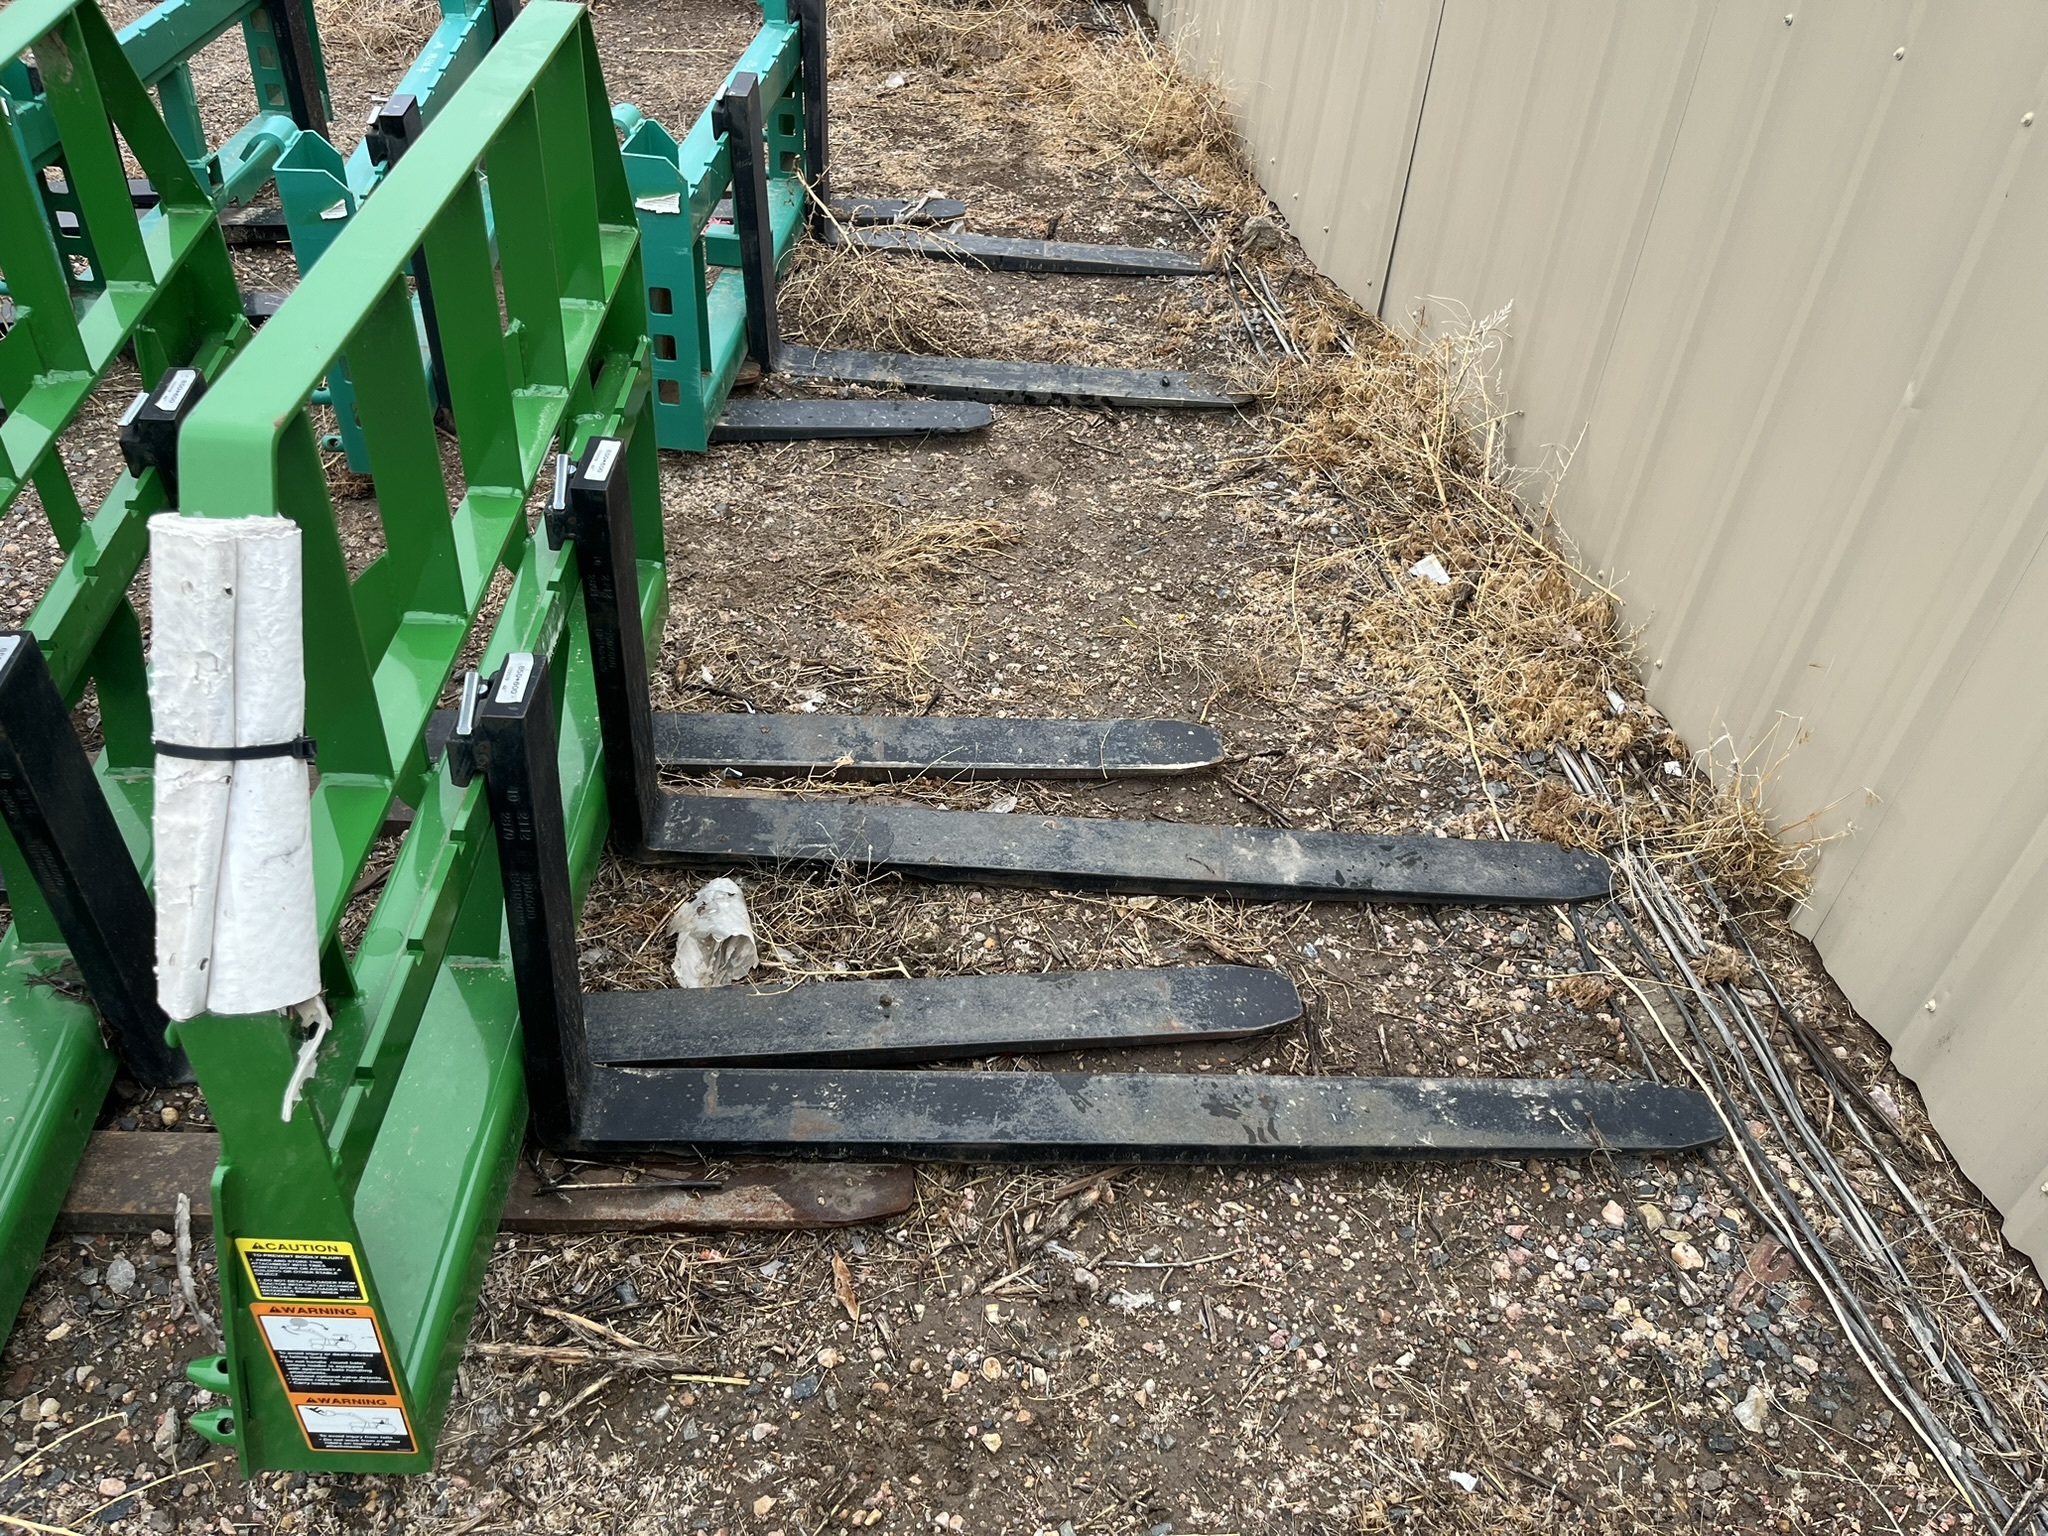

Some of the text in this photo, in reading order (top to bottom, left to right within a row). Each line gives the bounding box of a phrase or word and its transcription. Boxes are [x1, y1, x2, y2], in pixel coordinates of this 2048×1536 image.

[266, 1242, 338, 1252] CAUTION
[280, 1306, 357, 1316] WARNING
[318, 1398, 388, 1406] WARNING
